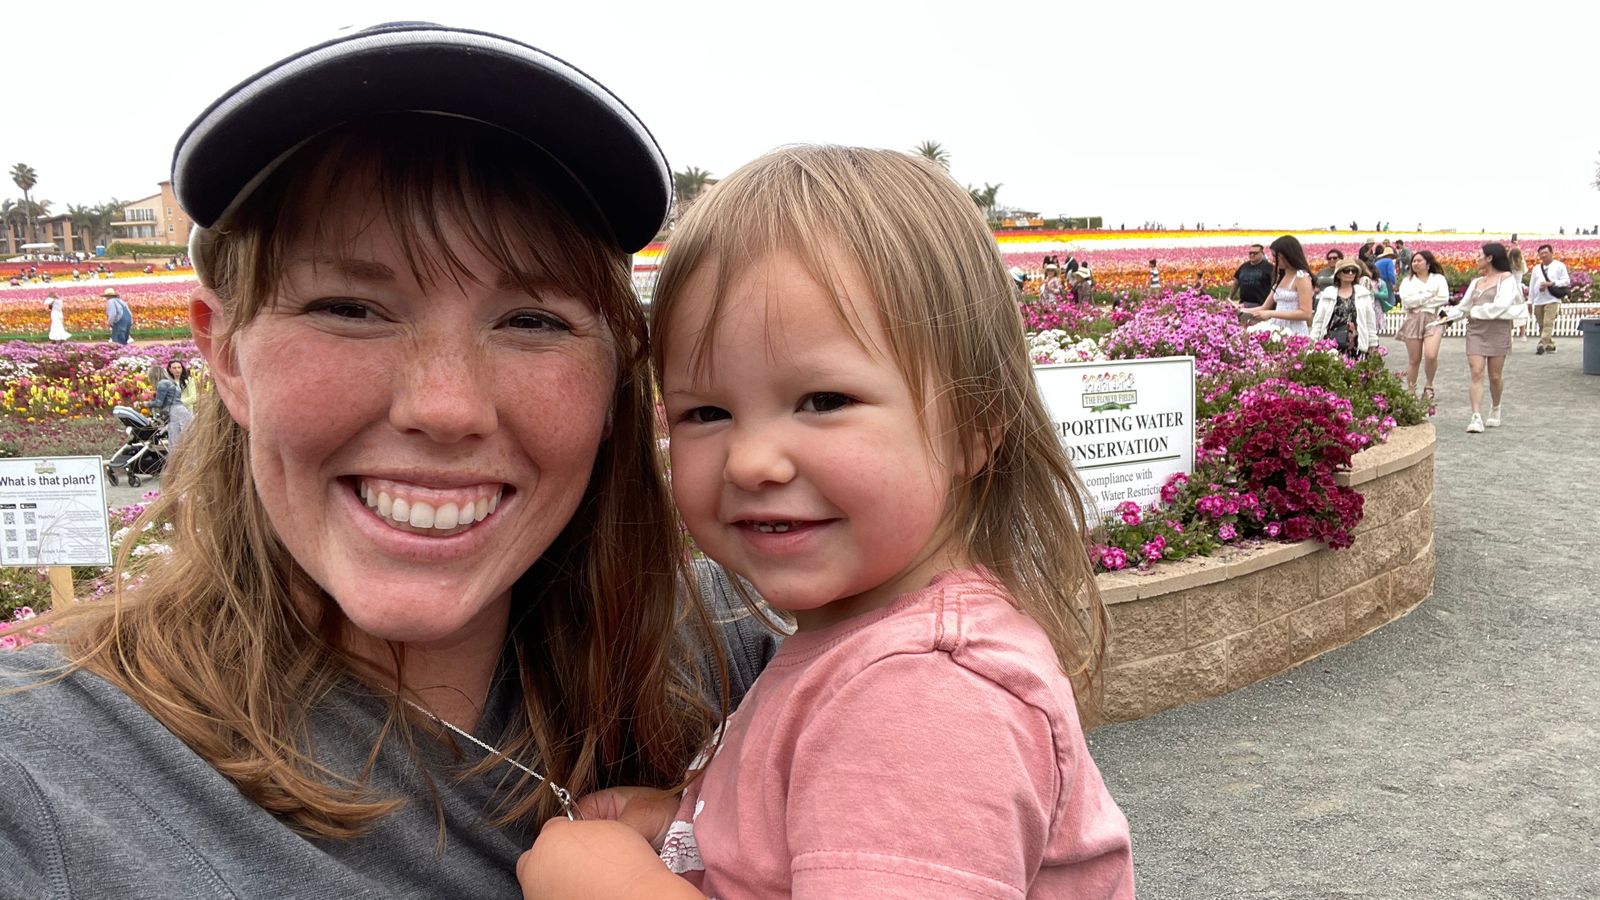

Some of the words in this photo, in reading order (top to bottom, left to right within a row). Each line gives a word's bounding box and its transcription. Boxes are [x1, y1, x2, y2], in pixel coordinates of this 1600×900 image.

[1085, 396, 1096, 404] THE
[1097, 395, 1118, 403] FLOWER
[1119, 393, 1135, 402] FIELDS
[1136, 412, 1184, 430] WATER
[1067, 436, 1168, 461] ONSERVATION
[0, 476, 25, 486] What
[28, 476, 37, 486] is
[39, 476, 60, 486] that
[62, 475, 96, 487] plant?
[1086, 472, 1133, 487] compliance
[1135, 468, 1153, 481] with
[1101, 490, 1125, 502] Water
